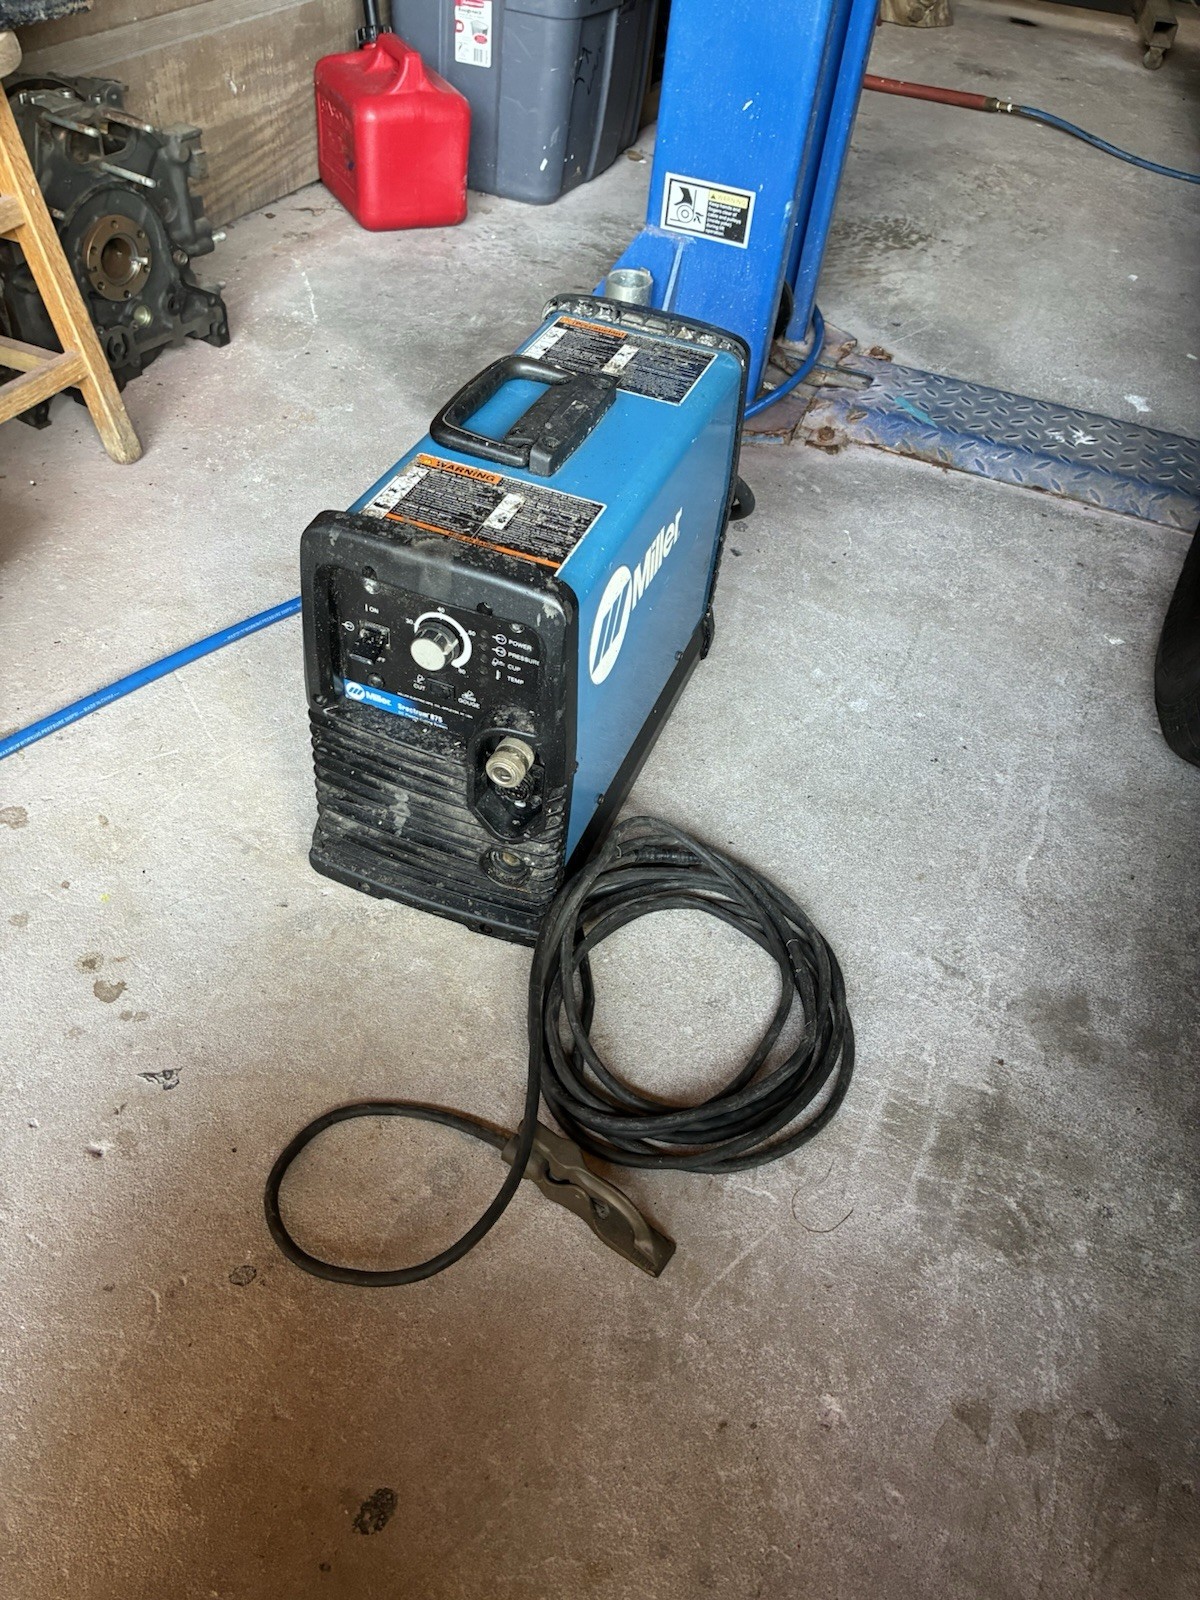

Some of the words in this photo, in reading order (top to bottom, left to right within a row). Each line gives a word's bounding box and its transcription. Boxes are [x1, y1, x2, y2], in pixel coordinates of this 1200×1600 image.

[436, 461, 496, 481] WARNING
[631, 507, 682, 611] Miller
[369, 606, 379, 614] ON
[508, 639, 533, 652] POWER
[507, 651, 540, 667] PRESSURE
[507, 663, 521, 672] CUP
[507, 675, 525, 685] TEMP
[413, 682, 426, 692] CUT
[457, 697, 481, 709] GOUGE
